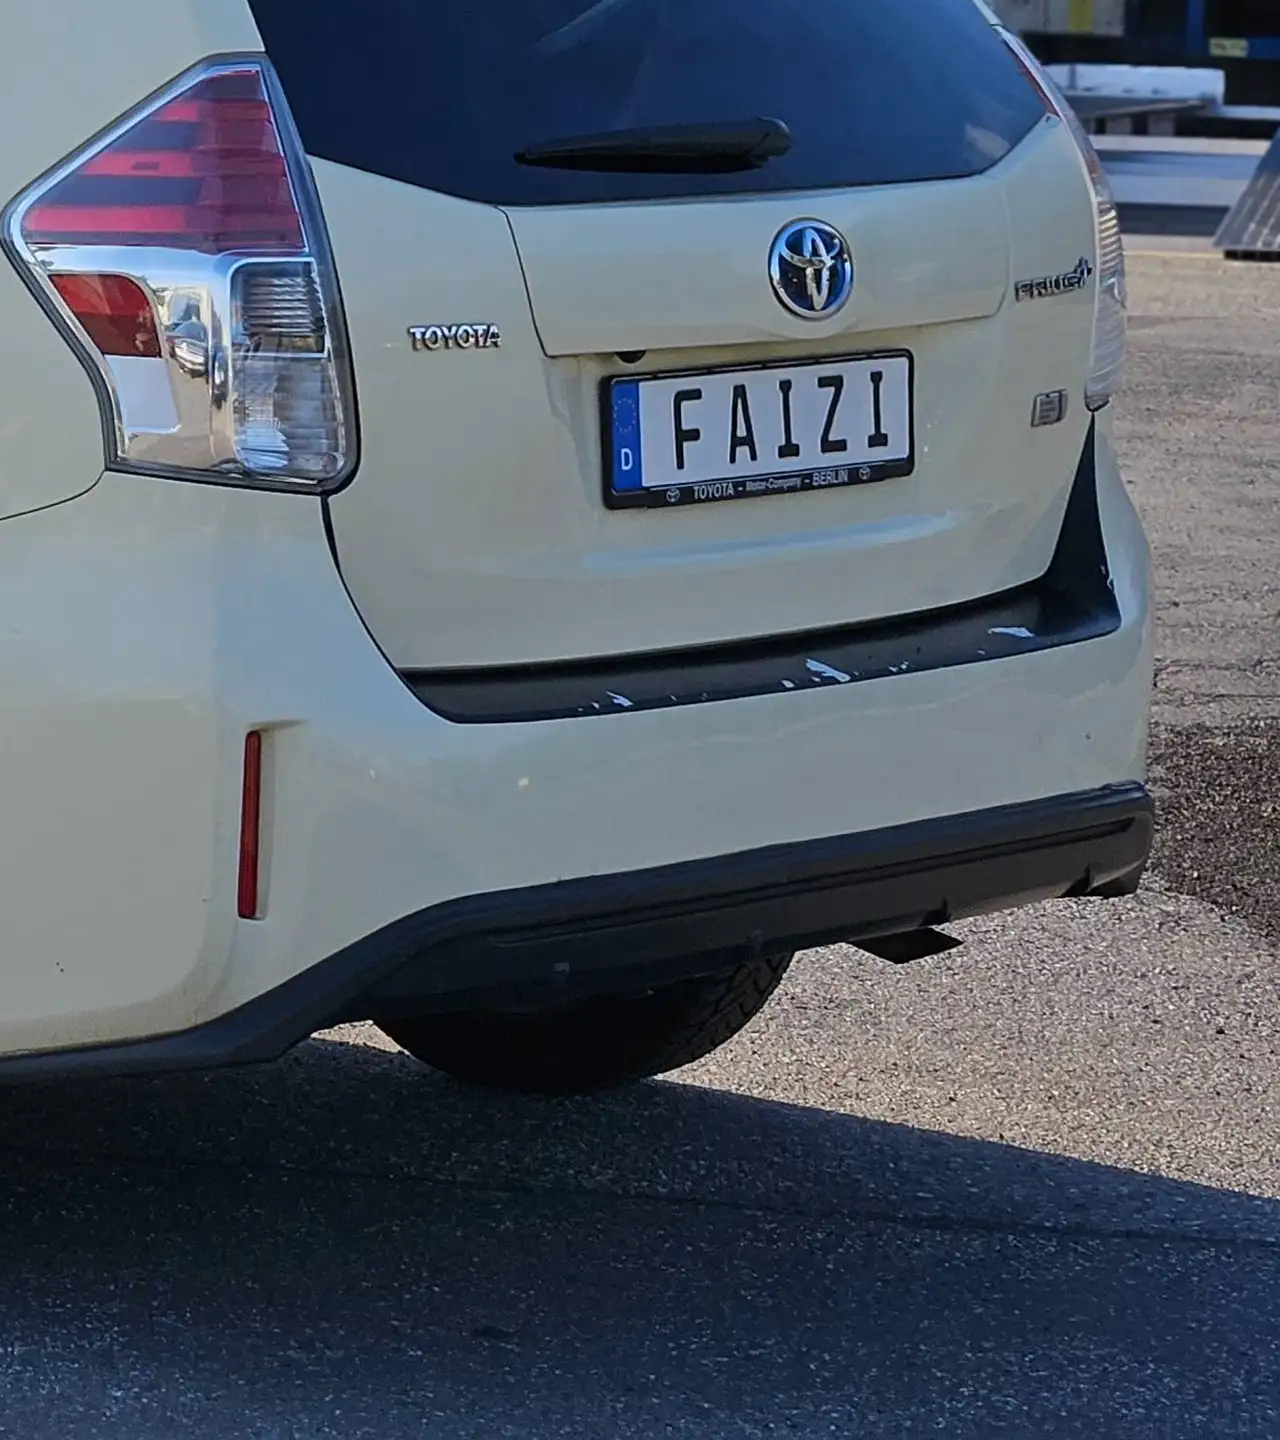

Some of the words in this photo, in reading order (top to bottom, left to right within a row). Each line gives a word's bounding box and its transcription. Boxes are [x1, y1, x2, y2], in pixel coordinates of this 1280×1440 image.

[408, 323, 501, 351] TOYOTA
[673, 371, 889, 470] FAIZI
[621, 448, 633, 471] D
[693, 482, 735, 501] TOYOTA
[746, 475, 802, 493] Motor-Company
[812, 469, 848, 488] BERLIN
